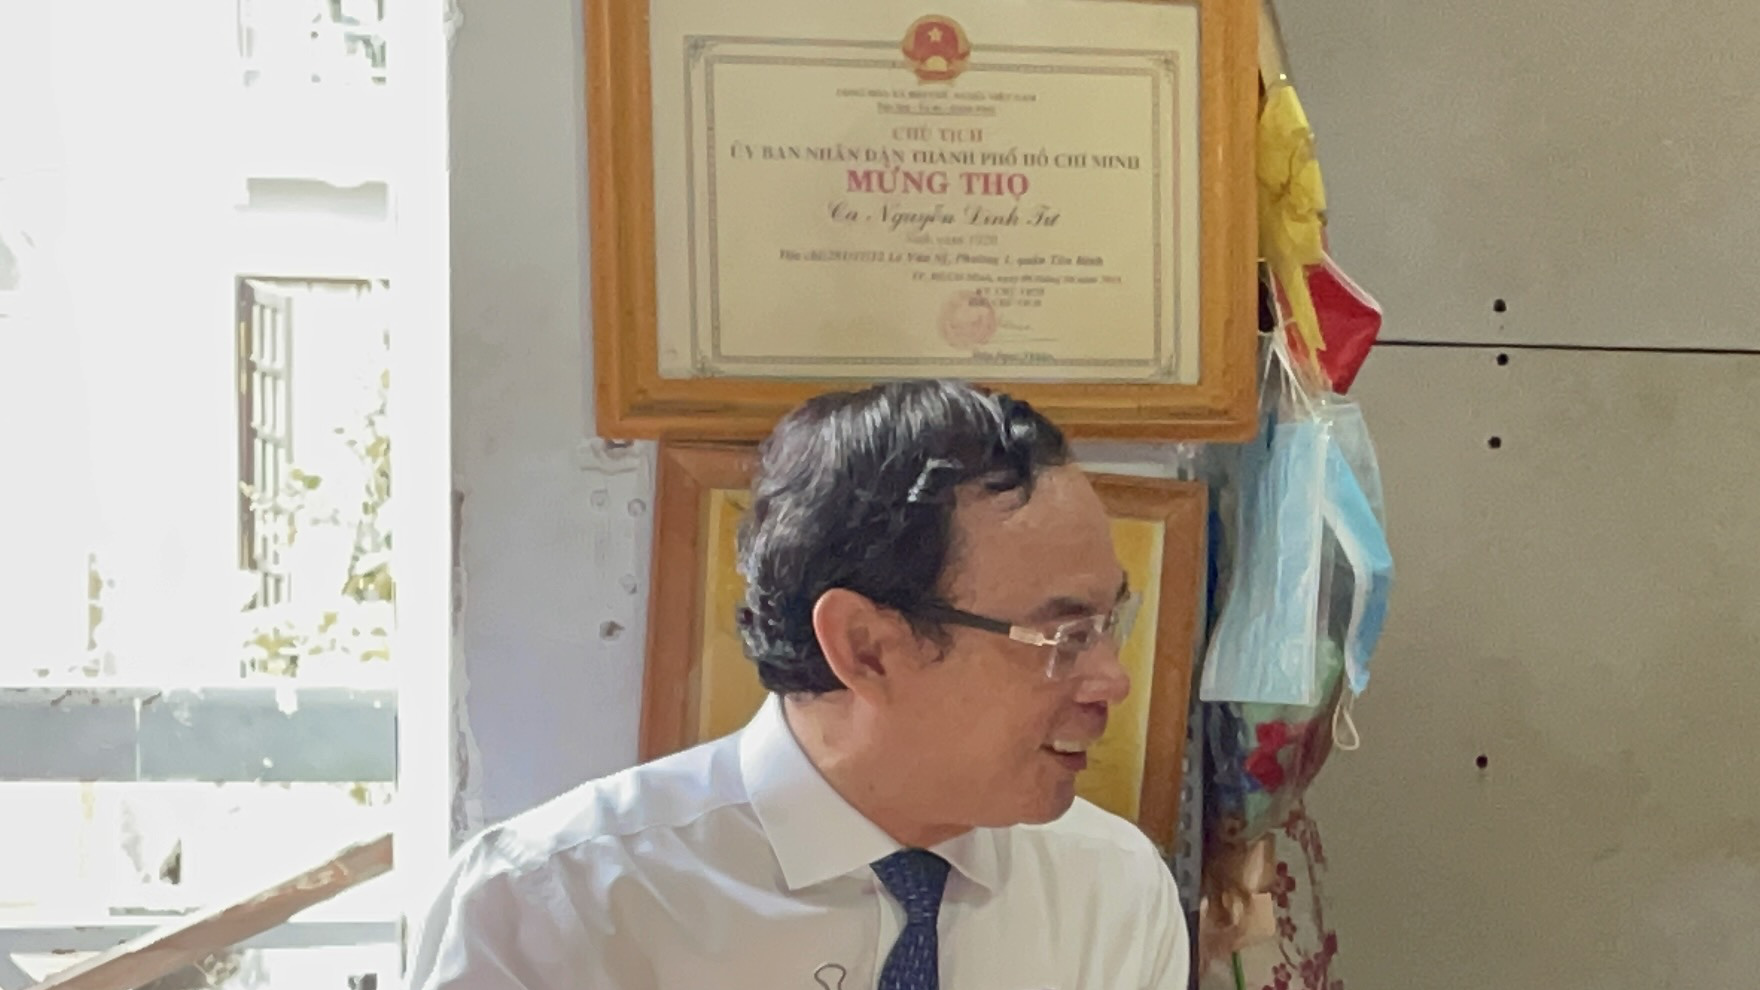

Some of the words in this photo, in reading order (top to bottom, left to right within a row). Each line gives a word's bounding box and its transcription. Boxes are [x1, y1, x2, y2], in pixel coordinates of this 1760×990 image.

[761, 146, 801, 160] BAN
[805, 143, 859, 162] NHÂN
[1091, 154, 1141, 170] MINH
[846, 161, 949, 194] MỪNG
[959, 170, 1031, 202] THỌ
